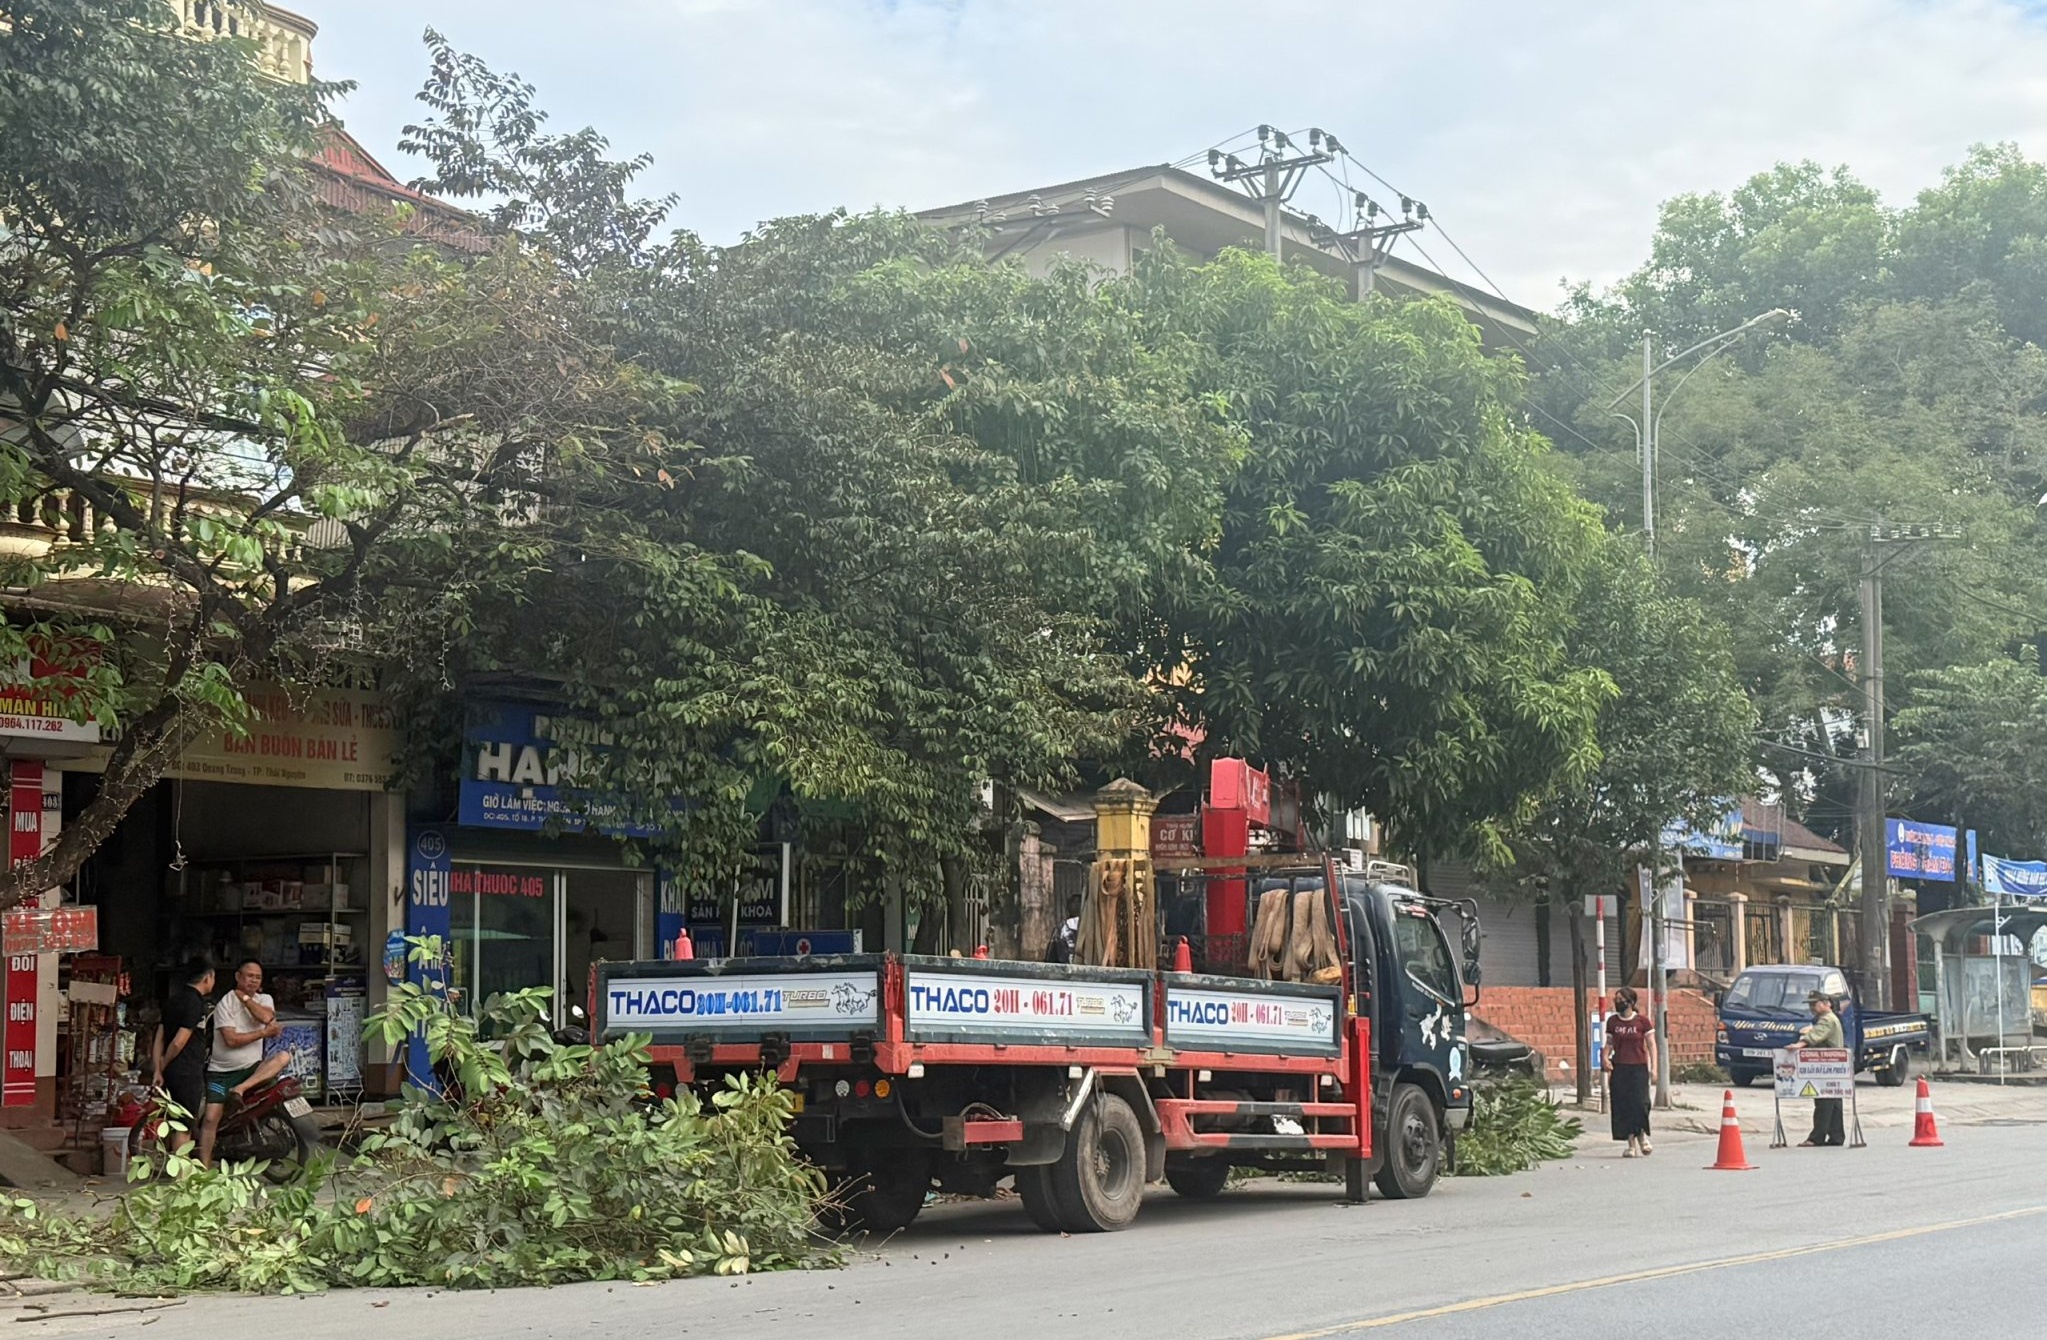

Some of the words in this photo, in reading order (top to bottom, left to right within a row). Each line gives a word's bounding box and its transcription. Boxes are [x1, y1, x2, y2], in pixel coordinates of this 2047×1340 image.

[261, 733, 302, 758] BUÔN
[307, 735, 337, 760] BÁN
[342, 734, 358, 762] LẺ
[483, 793, 500, 808] GIỜ
[501, 794, 521, 810] LÀM
[15, 811, 38, 833] MUA
[420, 837, 441, 851] 405
[1160, 828, 1177, 841] CƠ
[412, 862, 448, 907] SIÊU
[521, 877, 543, 897] 405
[741, 905, 773, 918] KHOA
[10, 997, 34, 1025] ĐIỆN
[610, 990, 695, 1015] THACO
[783, 990, 828, 1002] TURBO
[911, 986, 989, 1013] THACO
[994, 989, 1020, 1014] 20H
[1032, 991, 1073, 1016] 061.71
[1168, 1001, 1229, 1025] THACO
[1231, 1002, 1248, 1024] 20H
[1256, 1004, 1283, 1025] 061.71
[9, 1050, 33, 1074] THOẠI
